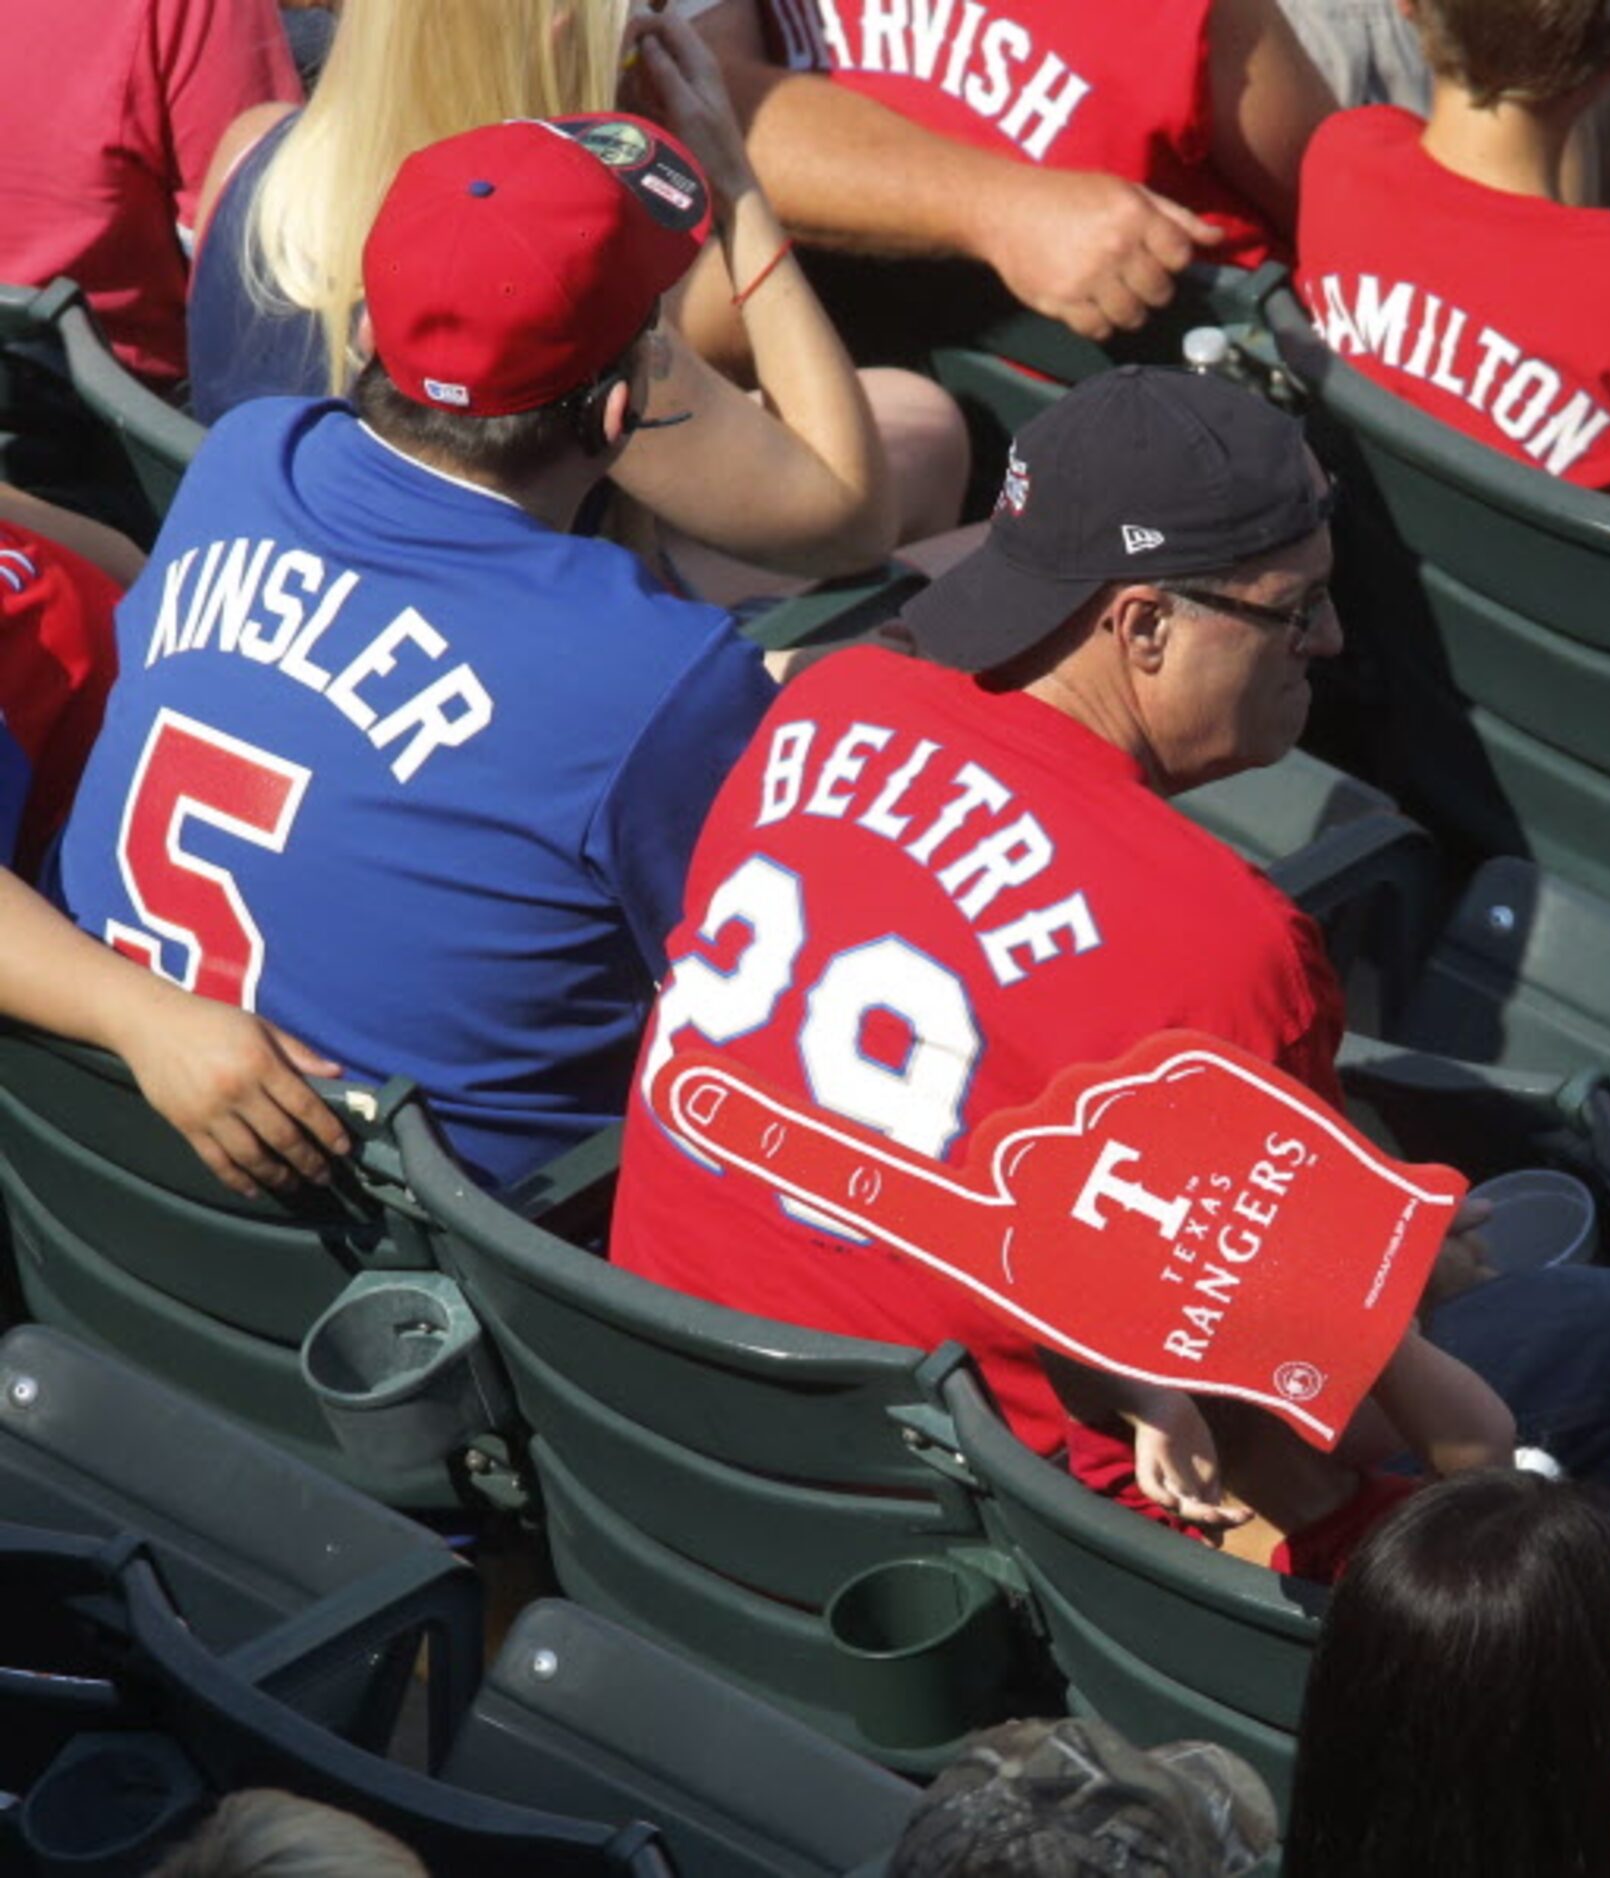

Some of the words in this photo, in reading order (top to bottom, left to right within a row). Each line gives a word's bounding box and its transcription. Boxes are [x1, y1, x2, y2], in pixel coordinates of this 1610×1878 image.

[144, 537, 495, 785] KINSLER
[104, 706, 313, 1014] 5
[754, 719, 1103, 989] BELTRE
[1070, 1138, 1193, 1240] T
[1160, 1172, 1232, 1284] TEXAS
[1163, 1131, 1307, 1362] RANGERS
